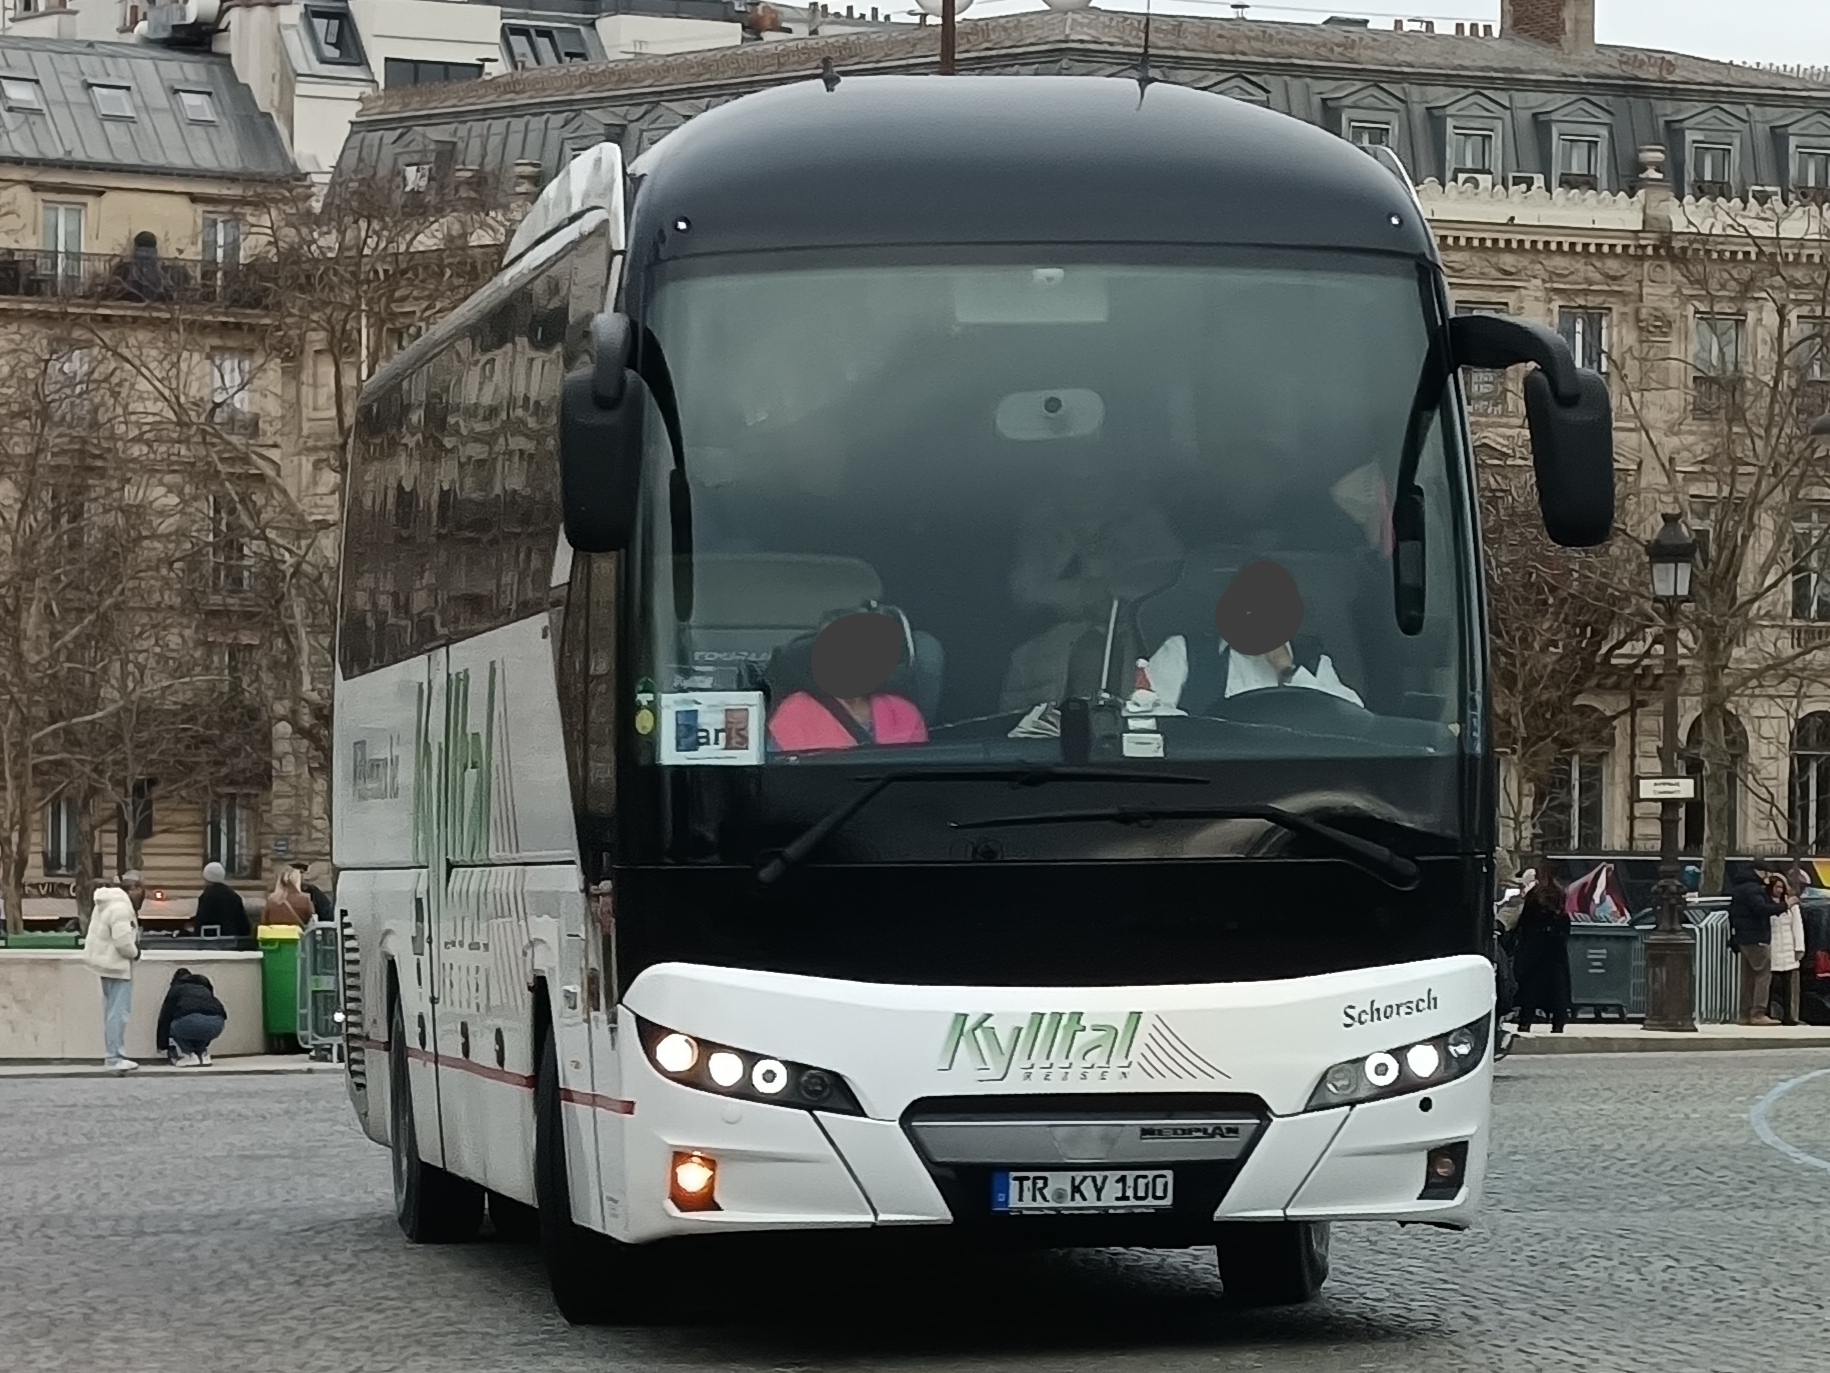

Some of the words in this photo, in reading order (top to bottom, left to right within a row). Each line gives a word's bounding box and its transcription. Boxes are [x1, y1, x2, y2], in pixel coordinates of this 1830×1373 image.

[1342, 987, 1438, 1029] Schorsch
[937, 1011, 1144, 1082] Kylltal
[1021, 1071, 1131, 1082] REISEN
[1012, 1175, 1050, 1203] TR
